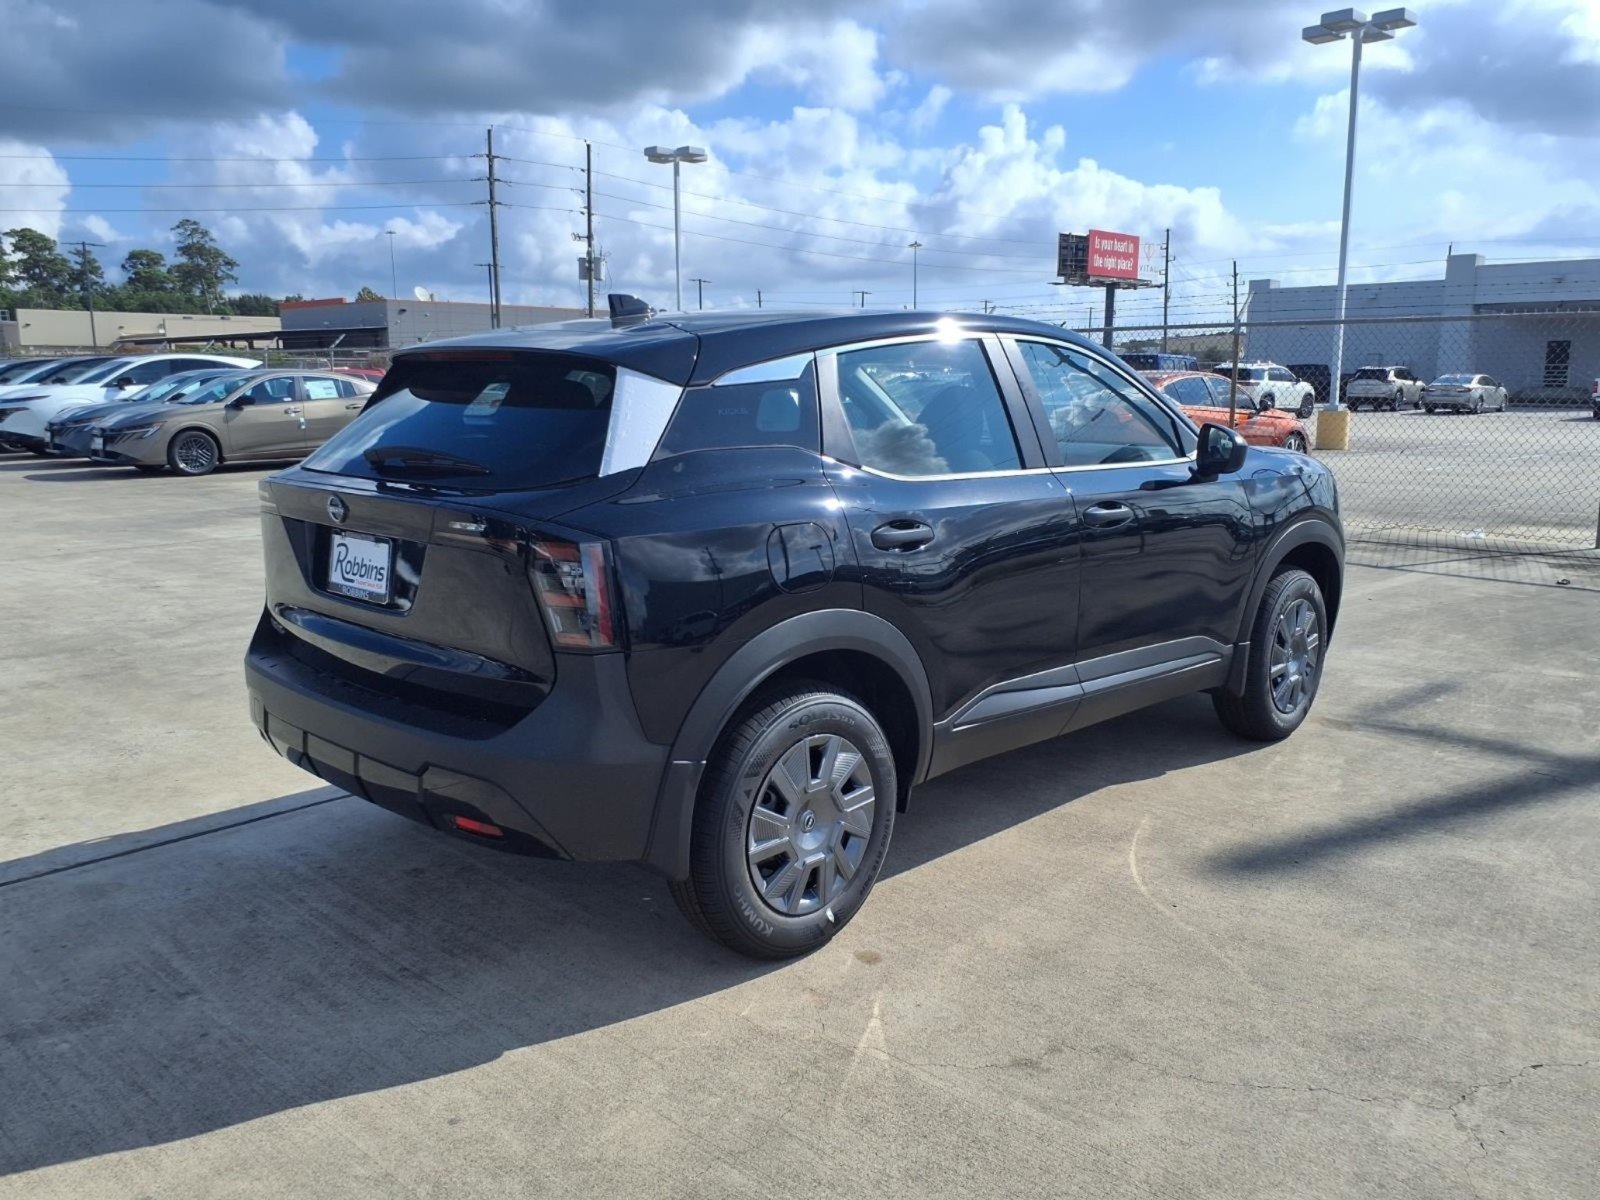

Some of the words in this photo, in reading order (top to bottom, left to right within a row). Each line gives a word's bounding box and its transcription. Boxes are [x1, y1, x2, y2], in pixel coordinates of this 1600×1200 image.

[1095, 236, 1100, 249] Is
[1101, 239, 1113, 252] your
[1114, 238, 1128, 253] heart
[1129, 241, 1134, 254] in
[1094, 254, 1103, 267] the
[1104, 256, 1117, 270] right
[1118, 257, 1134, 271] place?
[335, 543, 386, 583] Robbins
[342, 586, 369, 600] ROBBINS
[735, 881, 774, 936] KUMHO
